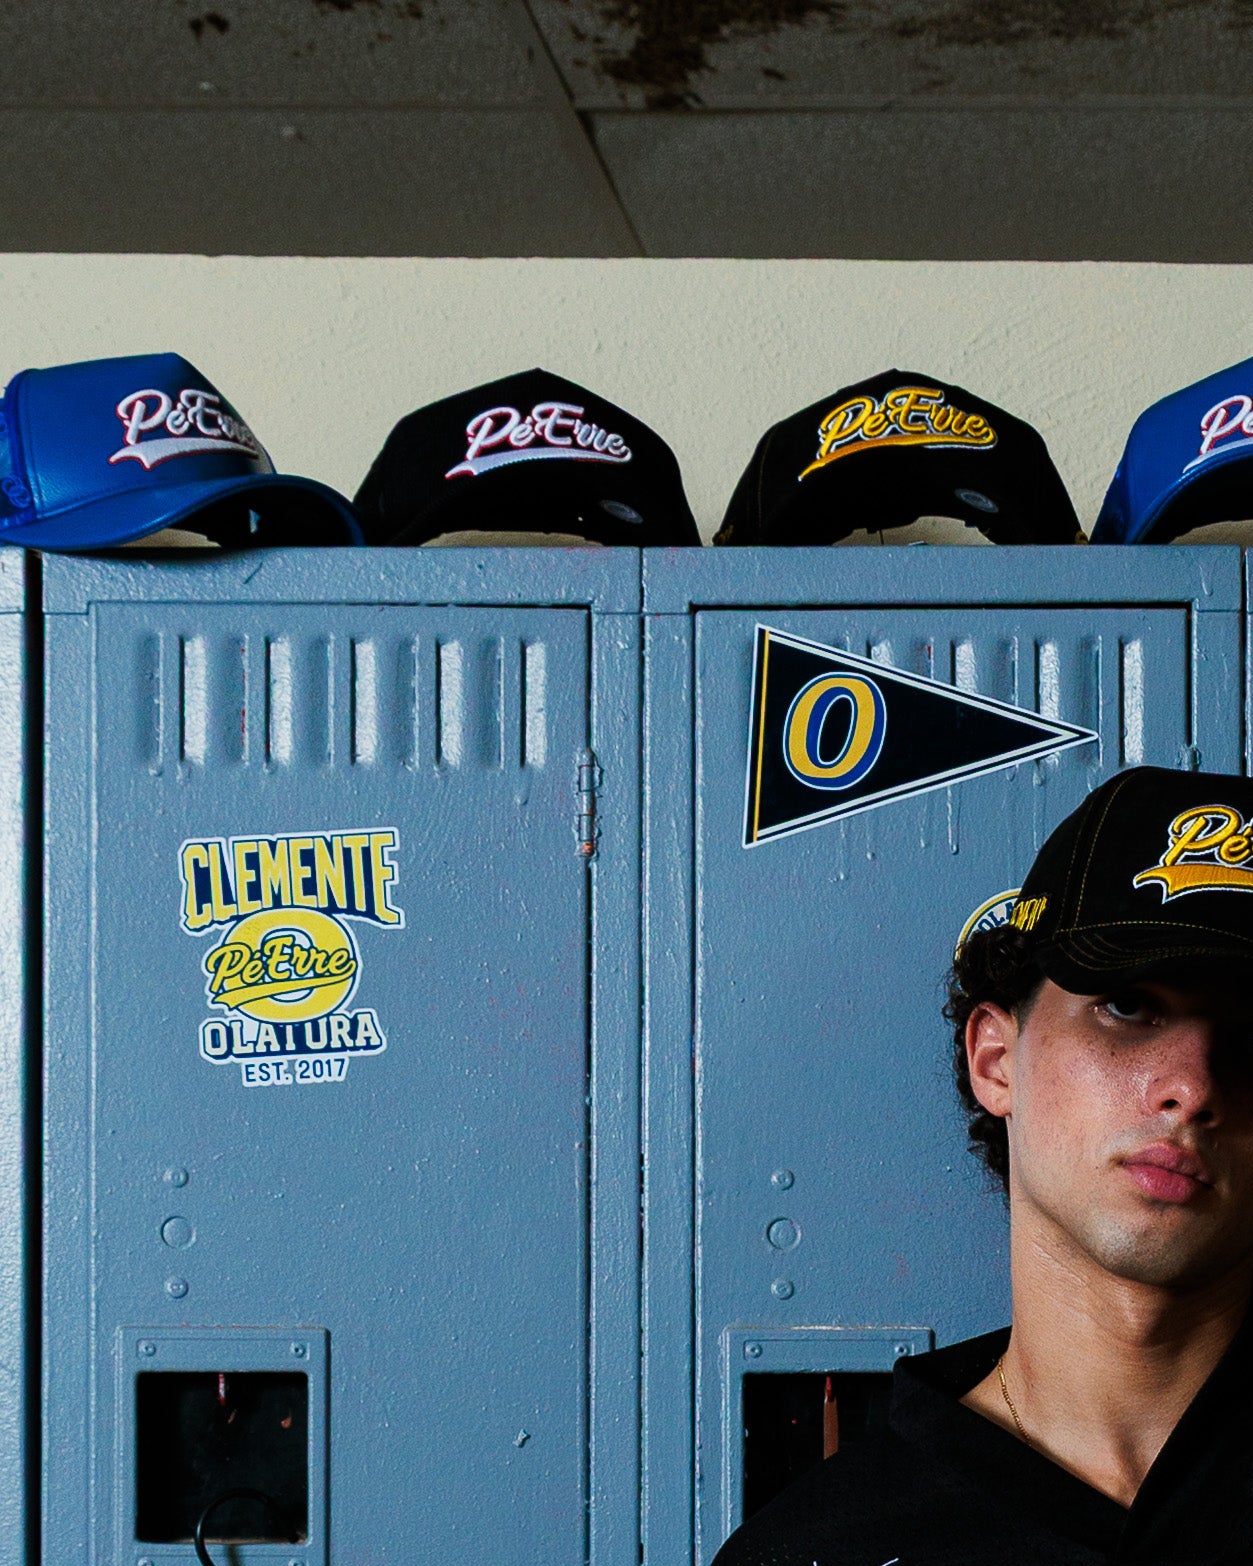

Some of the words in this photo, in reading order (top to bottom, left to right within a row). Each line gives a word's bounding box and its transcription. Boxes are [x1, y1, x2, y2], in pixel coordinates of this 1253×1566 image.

[182, 831, 400, 931] CLEMENTE
[205, 935, 358, 998] PéErre
[203, 1012, 383, 1059] OLATURA
[245, 1062, 290, 1083] EST.
[299, 1058, 346, 1080] 2017
